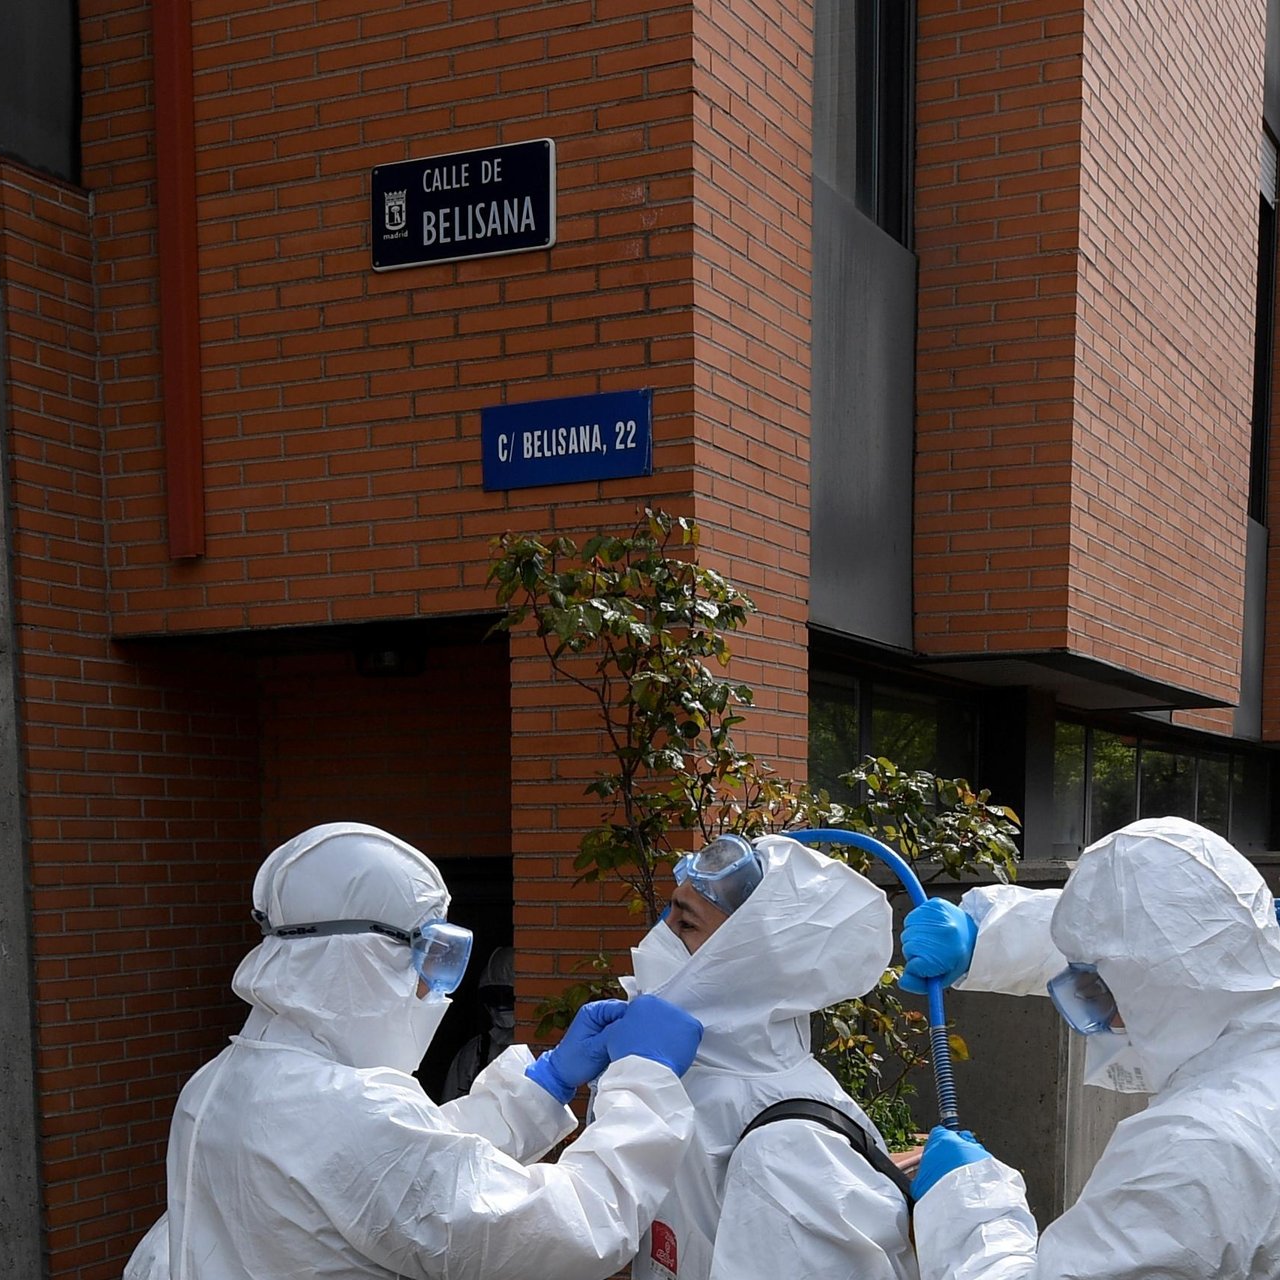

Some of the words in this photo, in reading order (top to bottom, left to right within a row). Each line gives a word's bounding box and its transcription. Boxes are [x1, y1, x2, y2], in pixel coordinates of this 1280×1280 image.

[423, 163, 470, 193] CALLE
[481, 158, 502, 184] DE
[383, 230, 408, 240] madrid
[423, 196, 536, 246] BELISANA
[498, 431, 515, 462] C/
[523, 424, 607, 459] BELISANA,
[615, 420, 637, 450] 22
